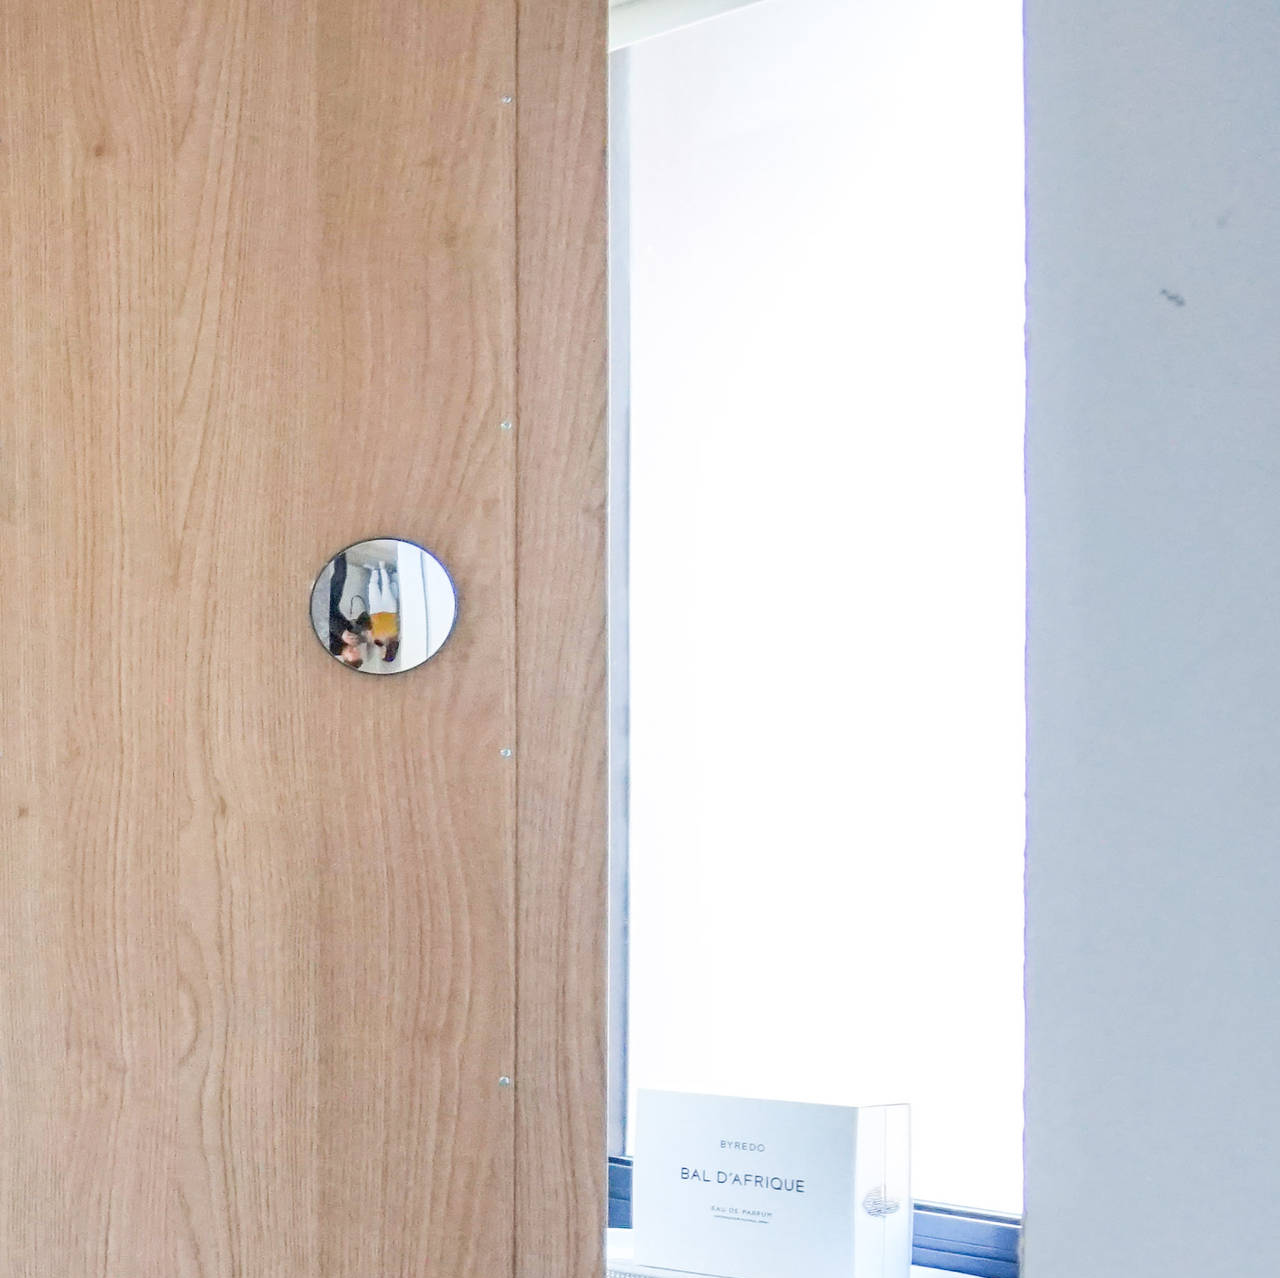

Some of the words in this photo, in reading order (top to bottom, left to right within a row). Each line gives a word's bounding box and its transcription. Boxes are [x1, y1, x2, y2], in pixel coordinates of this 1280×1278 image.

[719, 1139, 766, 1153] BYREDO
[680, 1166, 712, 1183] BAL
[716, 1170, 806, 1194] D'AFRIQUE
